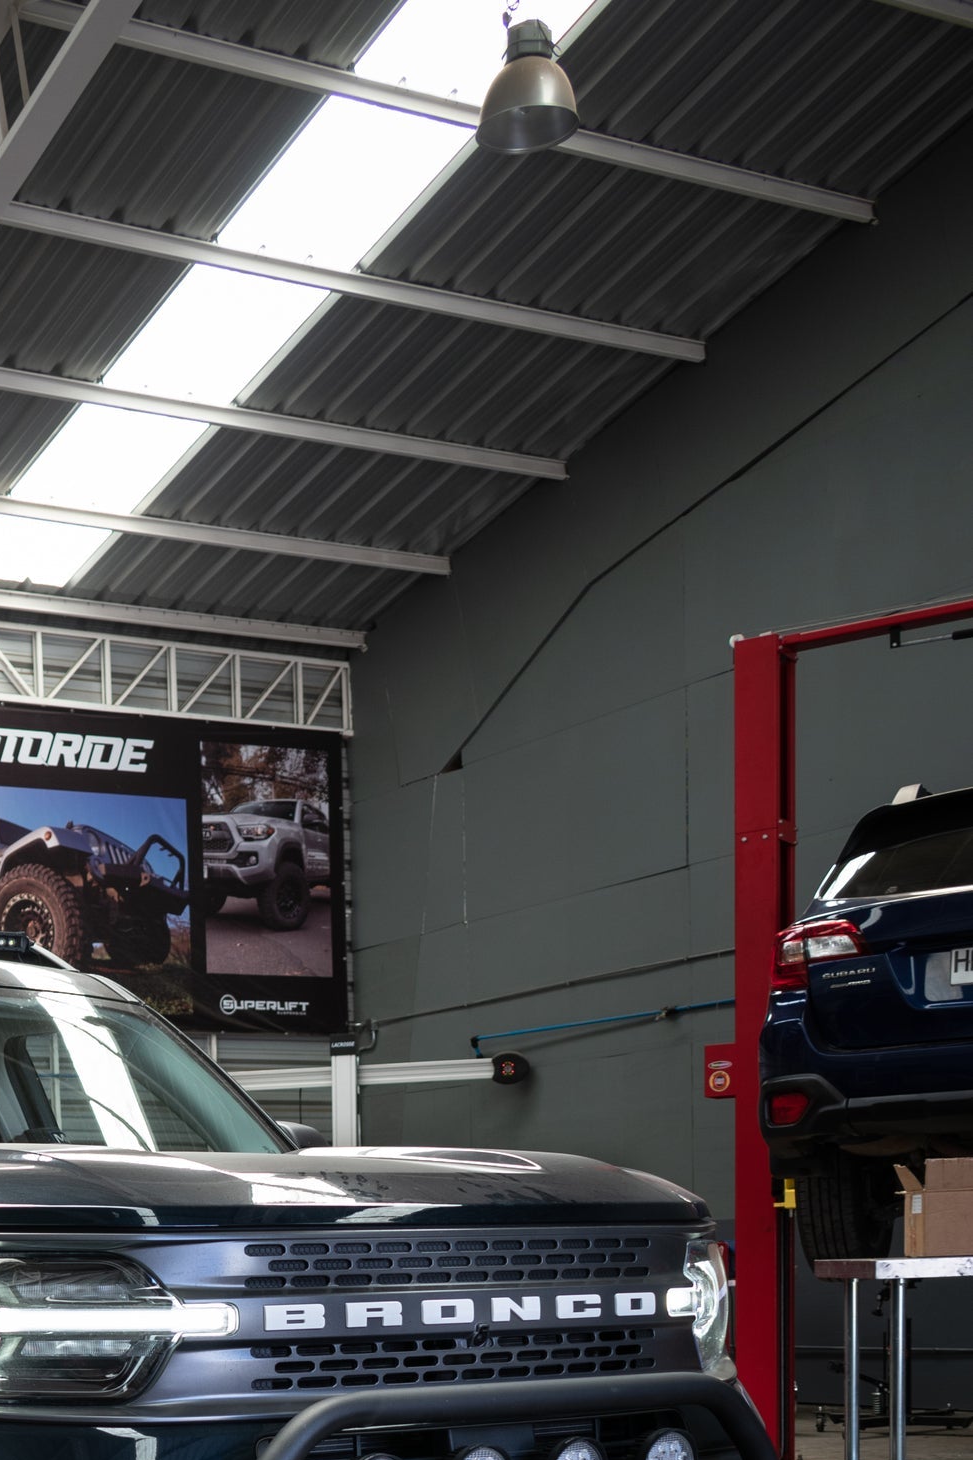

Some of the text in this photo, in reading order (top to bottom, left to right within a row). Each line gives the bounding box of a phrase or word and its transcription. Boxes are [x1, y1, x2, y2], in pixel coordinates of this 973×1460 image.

[822, 967, 876, 980] SUBARU
[221, 997, 310, 1012] SUPERLIFT
[263, 1292, 656, 1332] BRONCO
